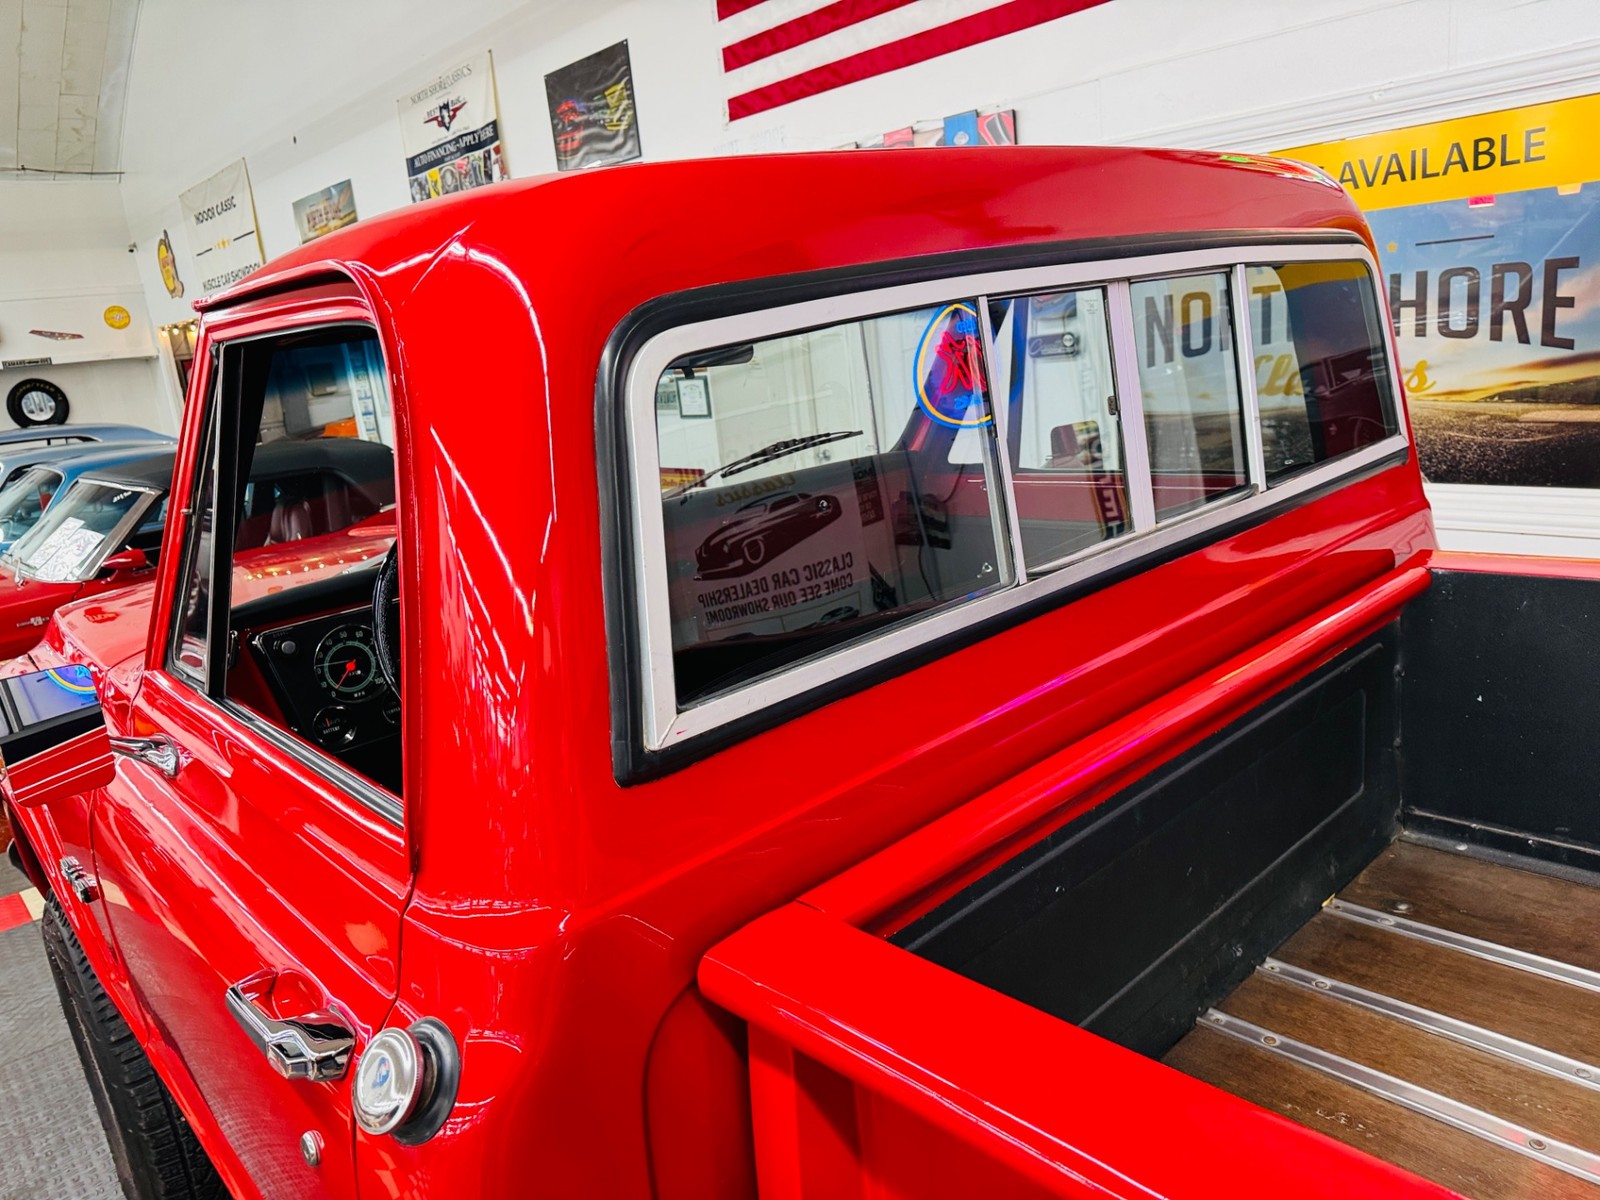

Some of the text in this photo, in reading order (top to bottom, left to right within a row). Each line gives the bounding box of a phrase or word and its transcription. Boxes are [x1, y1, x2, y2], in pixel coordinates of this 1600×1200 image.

[1339, 126, 1546, 190] AVAILABLE
[1144, 256, 1580, 369] NOT HORE
